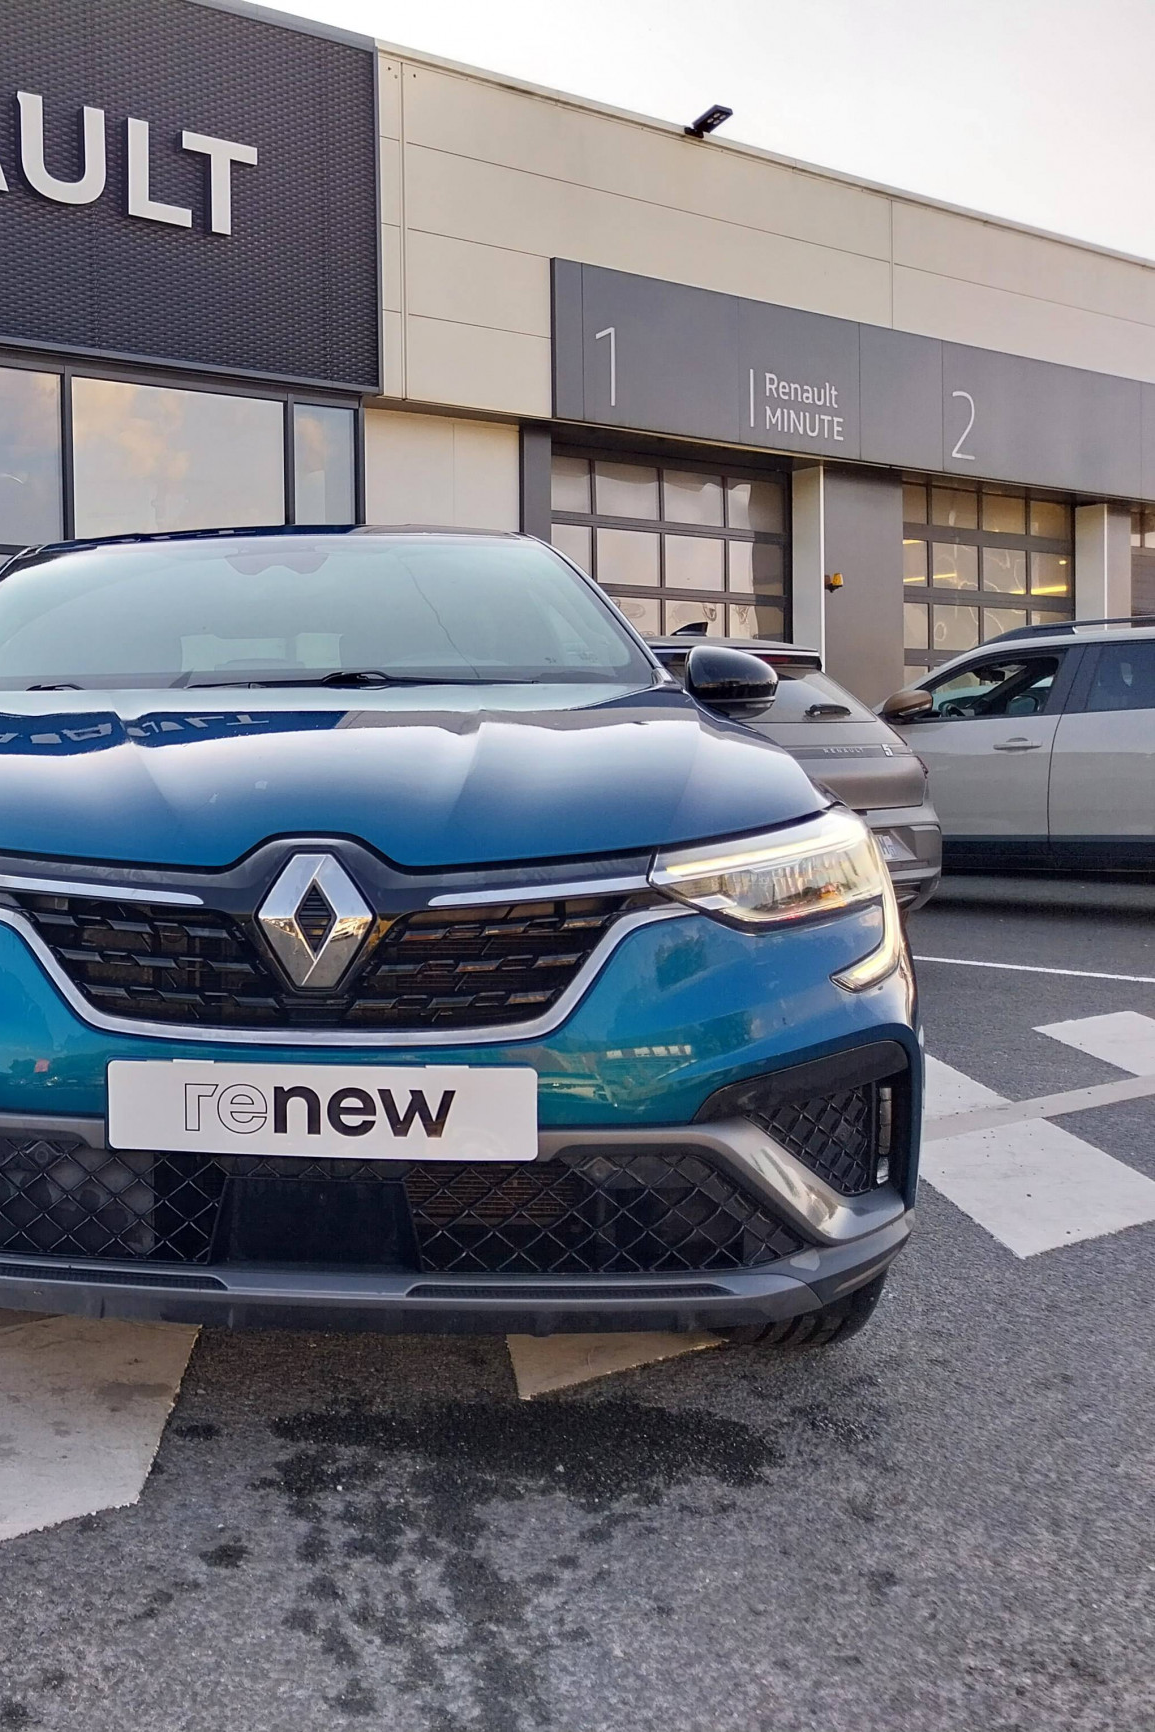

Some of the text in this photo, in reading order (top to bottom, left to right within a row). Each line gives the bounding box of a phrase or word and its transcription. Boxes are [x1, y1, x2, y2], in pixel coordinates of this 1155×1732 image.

[595, 326, 616, 407] 1
[764, 372, 839, 409] Renault
[764, 406, 844, 442] MINUTE
[951, 390, 976, 461] 2
[880, 743, 893, 757] 5
[184, 1083, 456, 1138] renew
